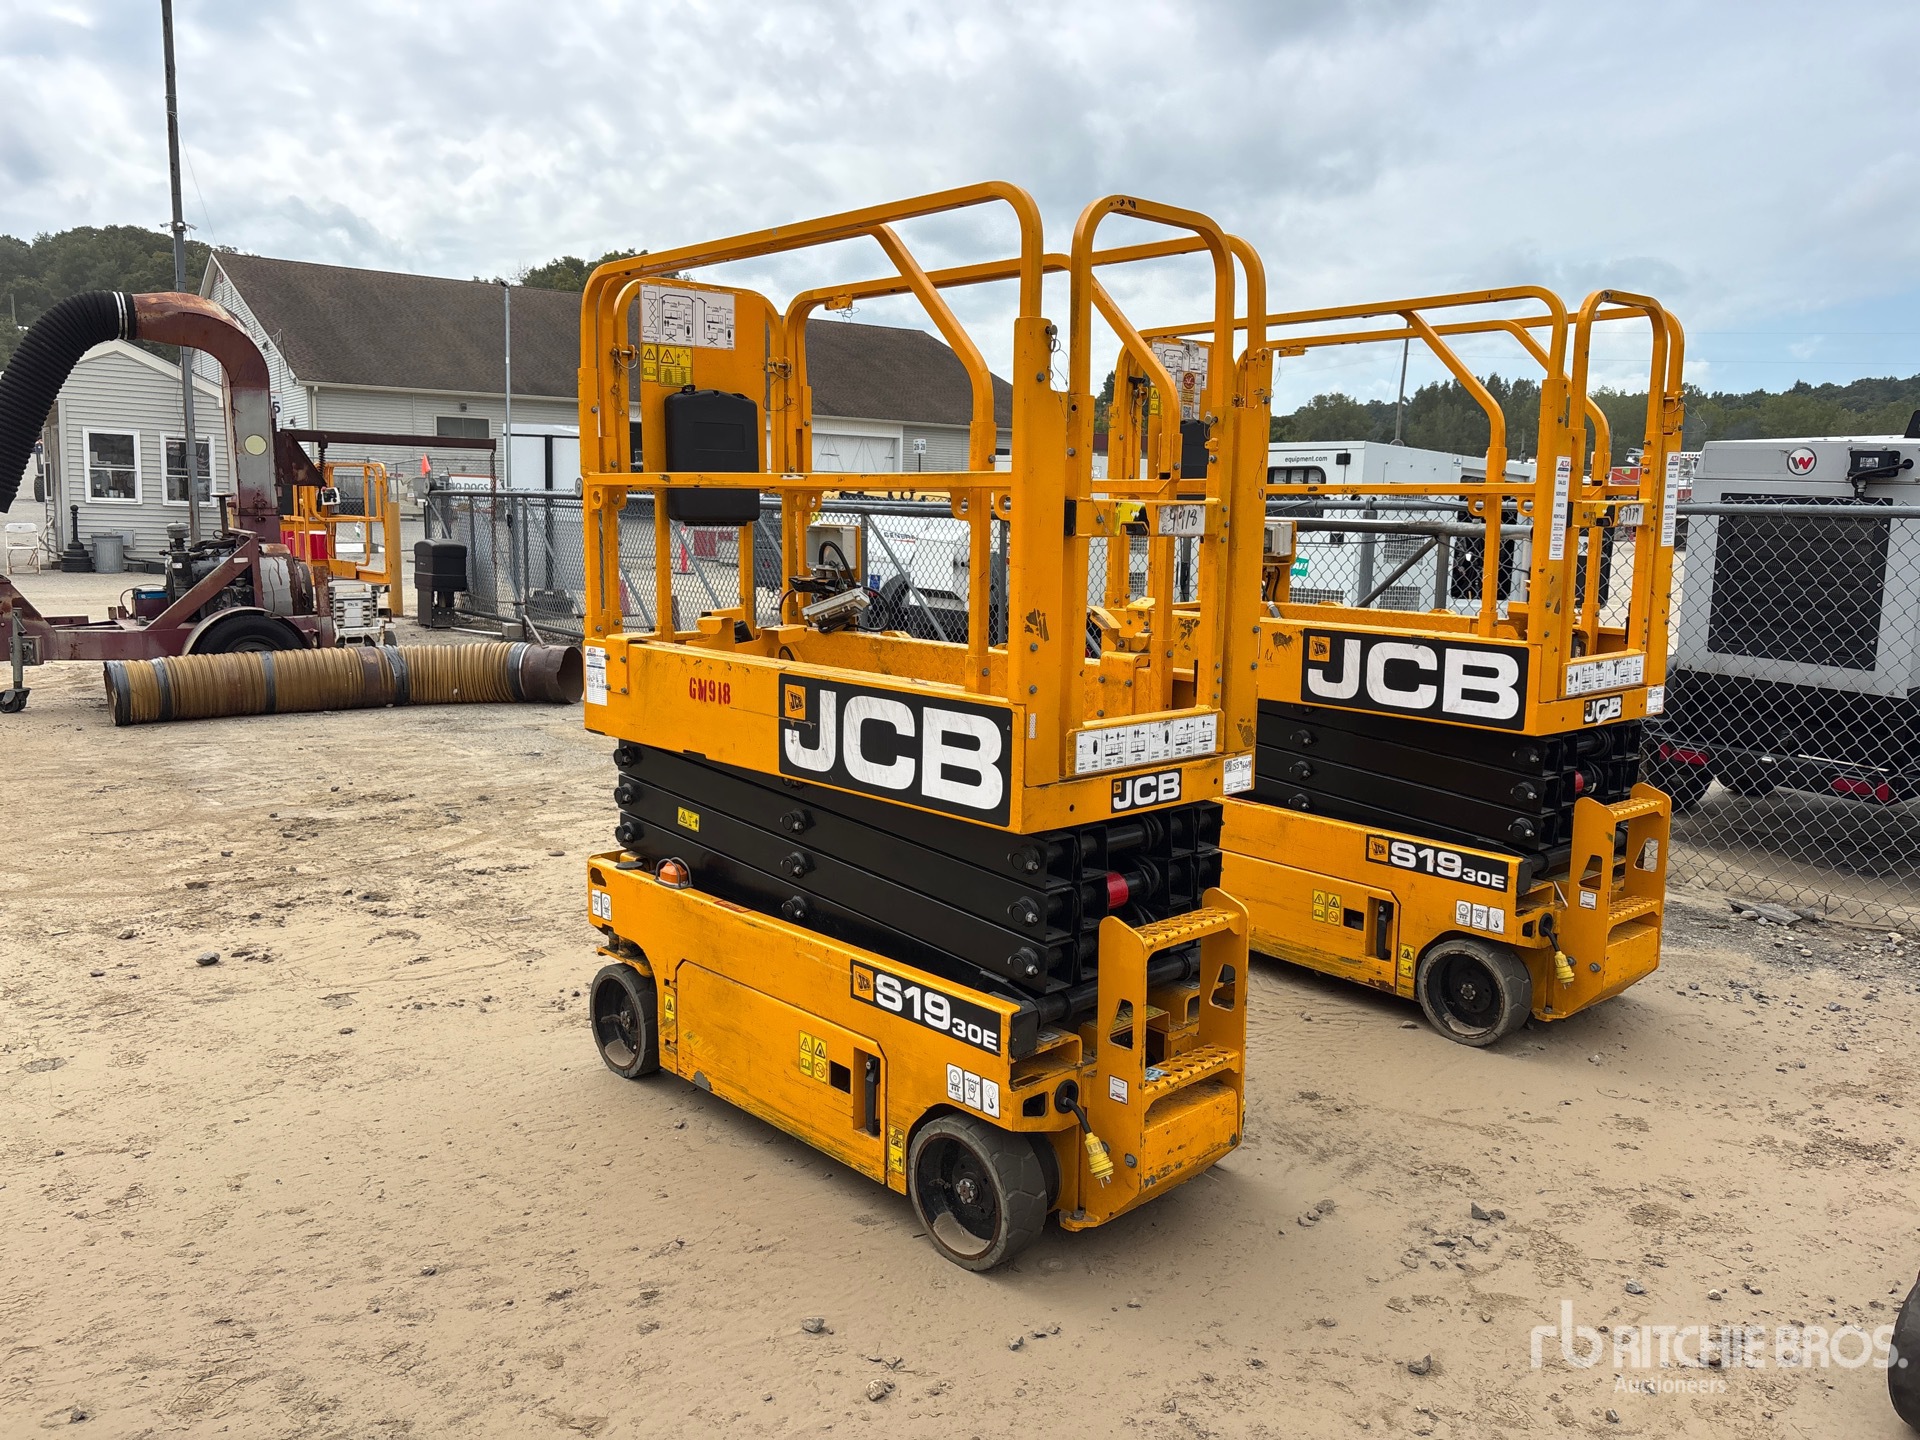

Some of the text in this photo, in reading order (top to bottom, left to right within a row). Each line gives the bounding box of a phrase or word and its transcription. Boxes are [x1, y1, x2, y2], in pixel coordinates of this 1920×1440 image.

[1284, 456, 1328, 464] equipment.com
[689, 676, 731, 705] GM918
[1307, 638, 1520, 720] JCB
[1584, 696, 1622, 723] JCB
[784, 689, 1004, 810] JCB
[1113, 771, 1180, 810] JCB
